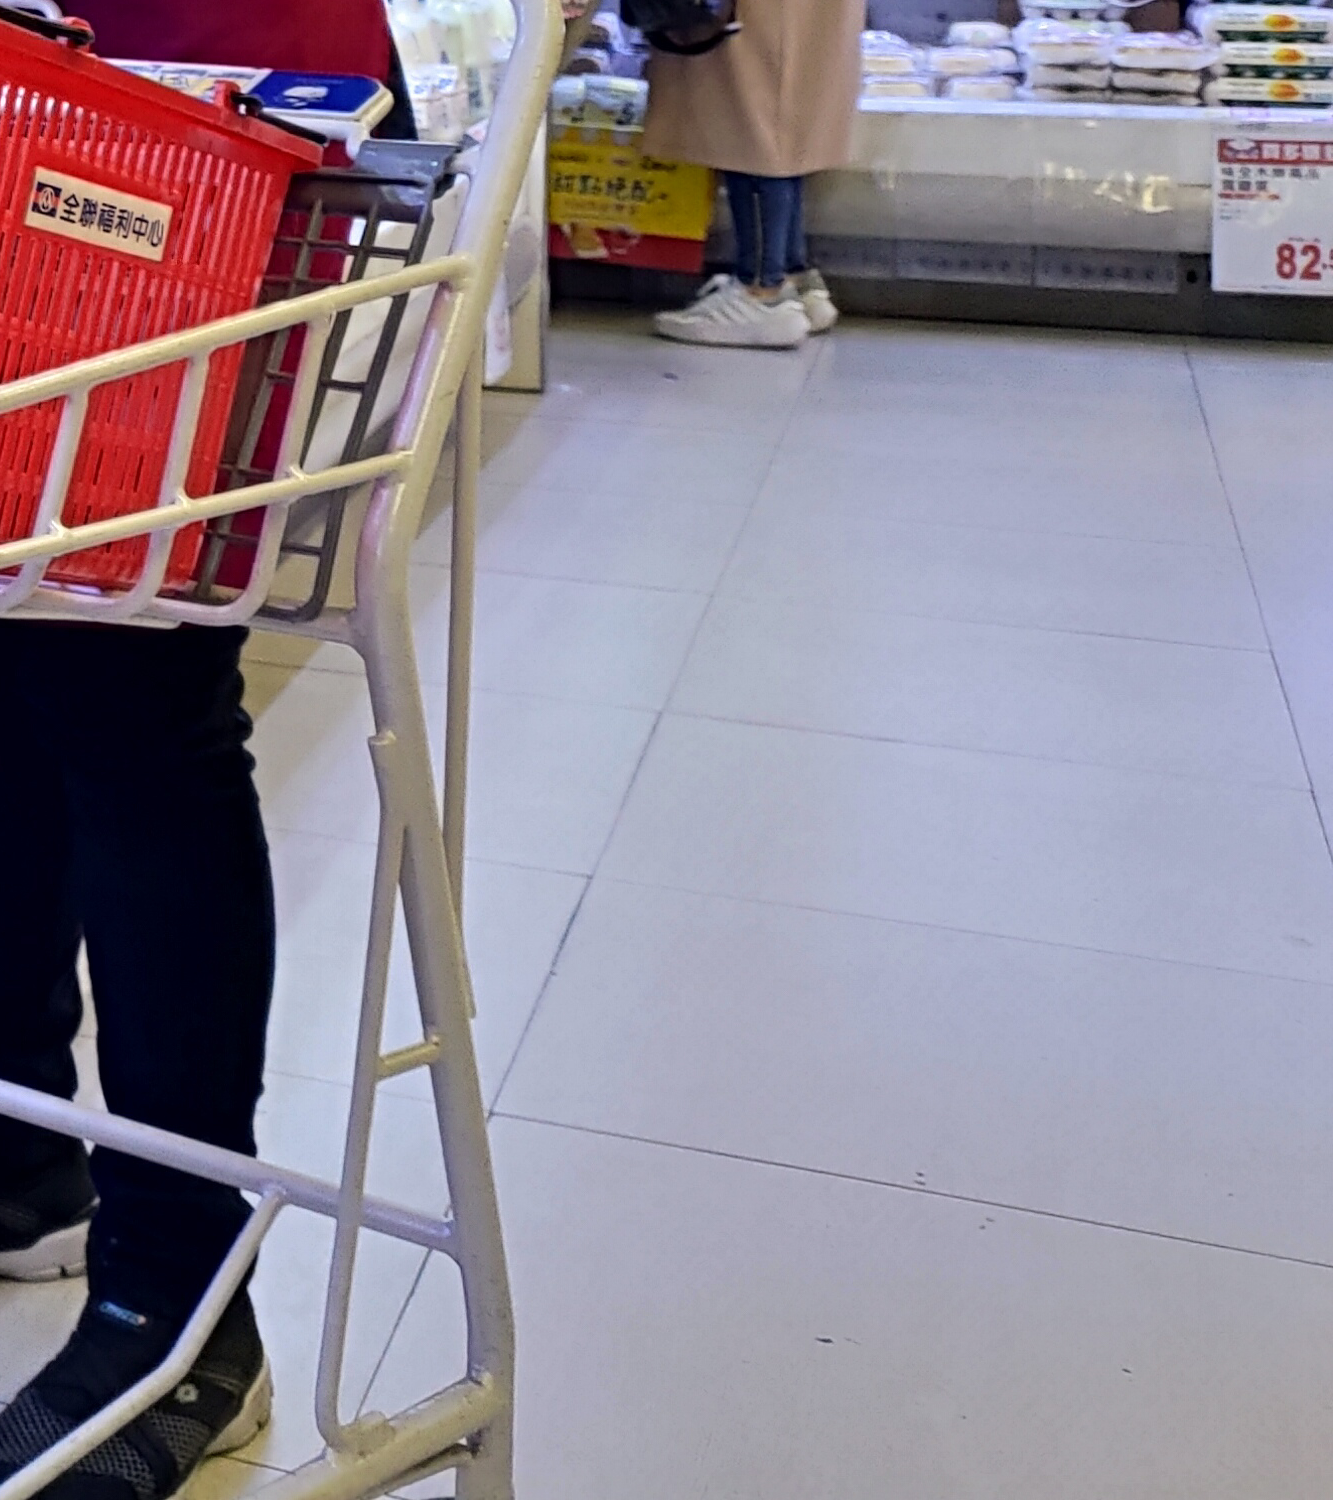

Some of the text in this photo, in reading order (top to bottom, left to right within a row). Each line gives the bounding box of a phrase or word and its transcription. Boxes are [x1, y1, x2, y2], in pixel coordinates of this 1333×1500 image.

[59, 193, 166, 249] 全聯福利中心
